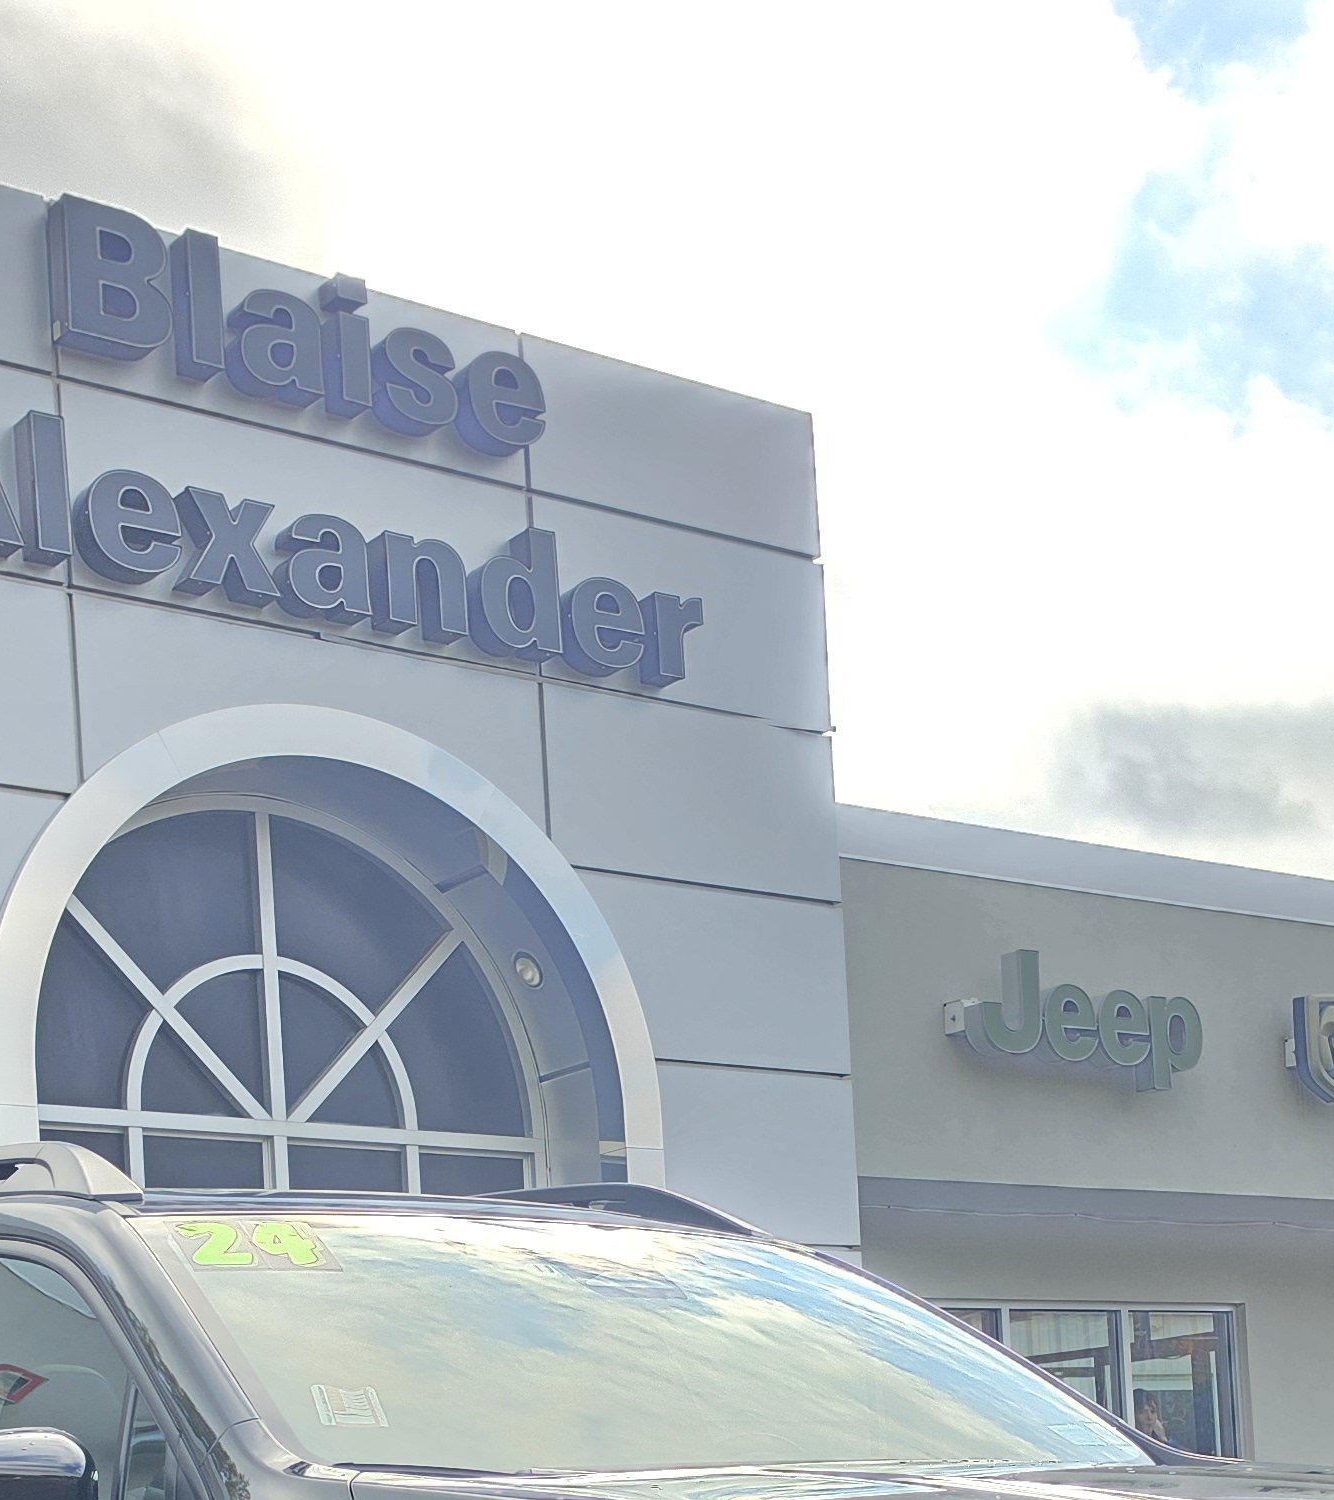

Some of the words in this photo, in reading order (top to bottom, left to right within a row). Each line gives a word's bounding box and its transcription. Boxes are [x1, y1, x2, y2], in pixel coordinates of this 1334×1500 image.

[48, 192, 547, 457] Blaise
[964, 948, 1203, 1092] Jeep
[174, 1221, 323, 1267] 24
